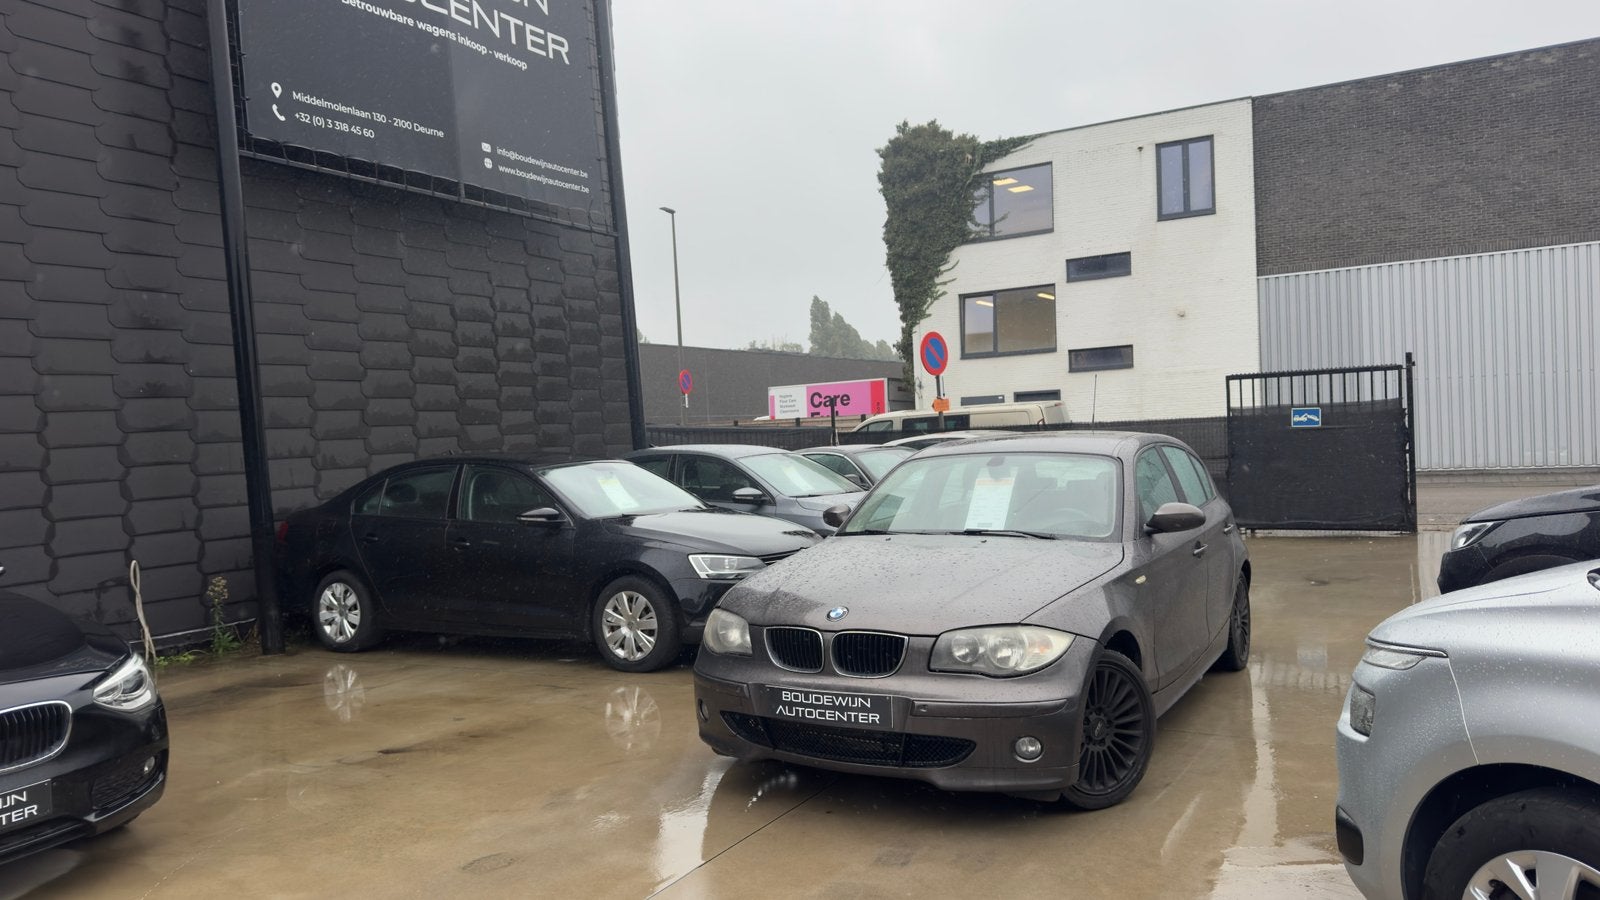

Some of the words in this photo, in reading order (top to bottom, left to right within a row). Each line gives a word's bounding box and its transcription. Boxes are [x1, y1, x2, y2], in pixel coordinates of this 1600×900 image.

[404, 0, 570, 65] ENTER
[416, 19, 456, 41] wagens
[457, 32, 487, 55] inkoop
[493, 49, 528, 71] verkoop
[292, 90, 371, 120] Middelmolenlaan
[371, 111, 387, 124] 130
[393, 117, 413, 130] 2100
[413, 122, 445, 138] Deurne
[294, 111, 311, 124] +32
[312, 115, 325, 128] (0)
[326, 118, 333, 129] 3
[334, 120, 349, 132] 318
[350, 124, 362, 136] 45
[363, 127, 375, 139] 60
[496, 146, 588, 178] info@boudewijnautocenter.be
[498, 164, 590, 194] www.boudewijnautocenter.be
[810, 391, 850, 408] Care
[776, 705, 880, 724] AUTOCENTER
[782, 691, 870, 708] BOUDEWIJN
